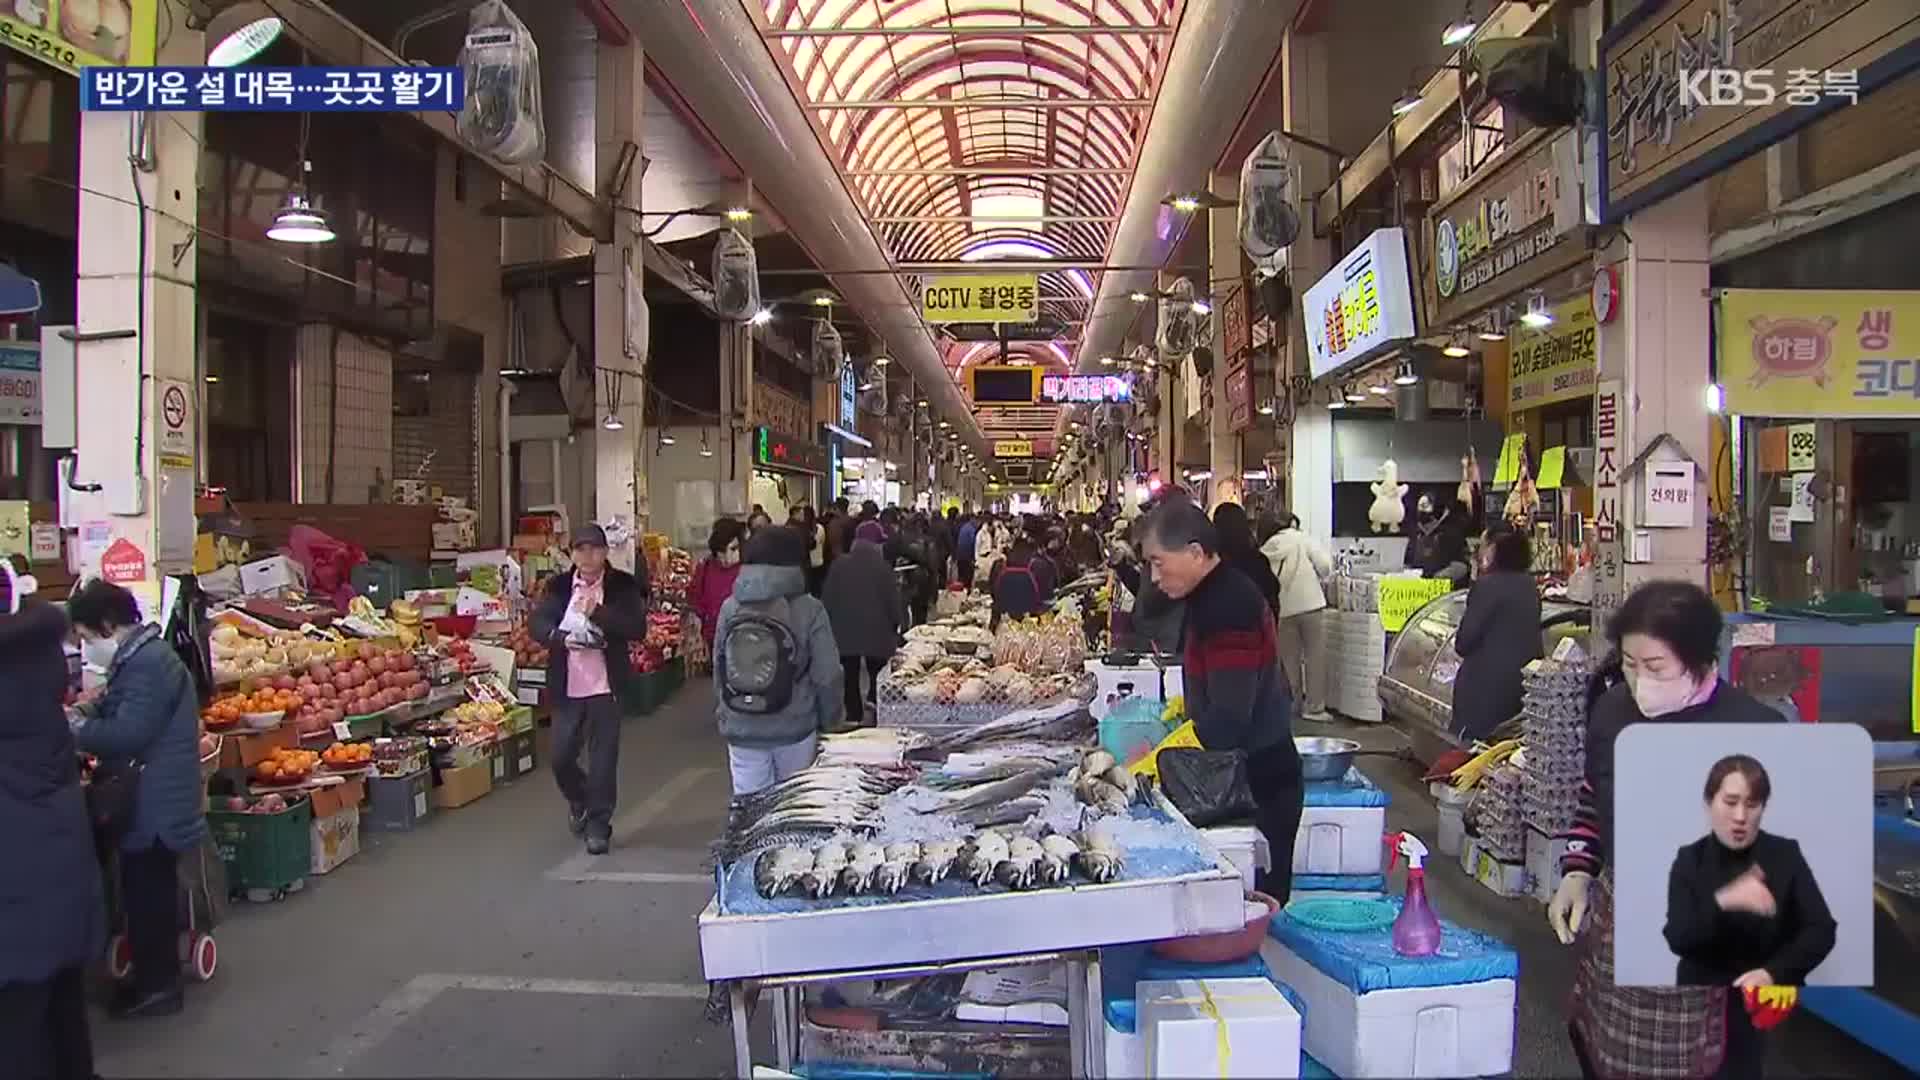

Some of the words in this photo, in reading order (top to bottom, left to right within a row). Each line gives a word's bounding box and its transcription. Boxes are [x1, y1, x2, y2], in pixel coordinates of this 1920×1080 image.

[925, 287, 971, 309] CCTV
[1856, 310, 1892, 350] 생
[1765, 337, 1817, 361] 하림
[1598, 393, 1616, 543] 불조심
[1651, 487, 1688, 503] 건의함
